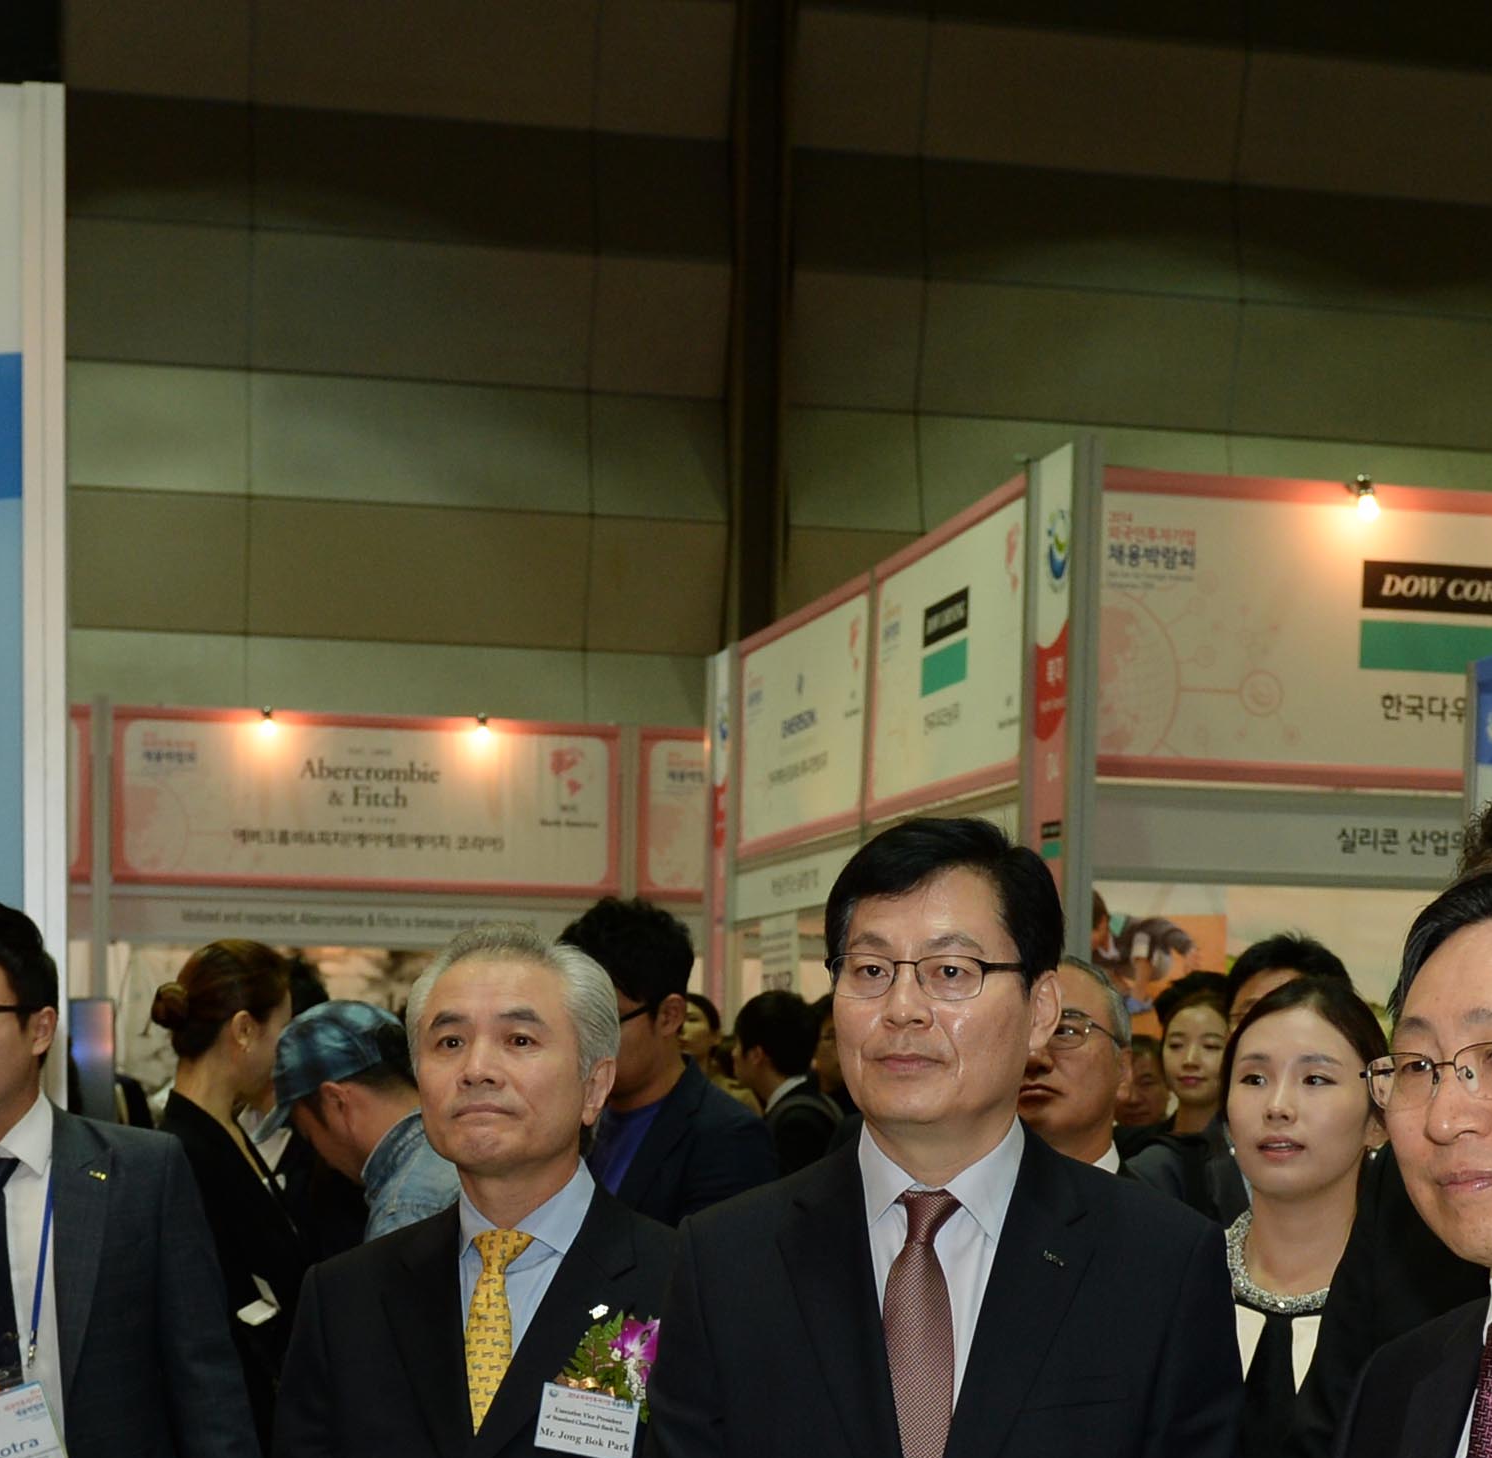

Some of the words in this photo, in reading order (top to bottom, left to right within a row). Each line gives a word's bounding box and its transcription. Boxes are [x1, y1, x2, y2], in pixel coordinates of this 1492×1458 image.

[1381, 573, 1445, 600] DOW
[300, 756, 440, 784] Abercrombie
[328, 790, 345, 807] &
[353, 785, 408, 808] Fitch
[1337, 827, 1400, 855] 실리콘
[539, 1426, 556, 1438] Mr.
[607, 1439, 630, 1452] Park
